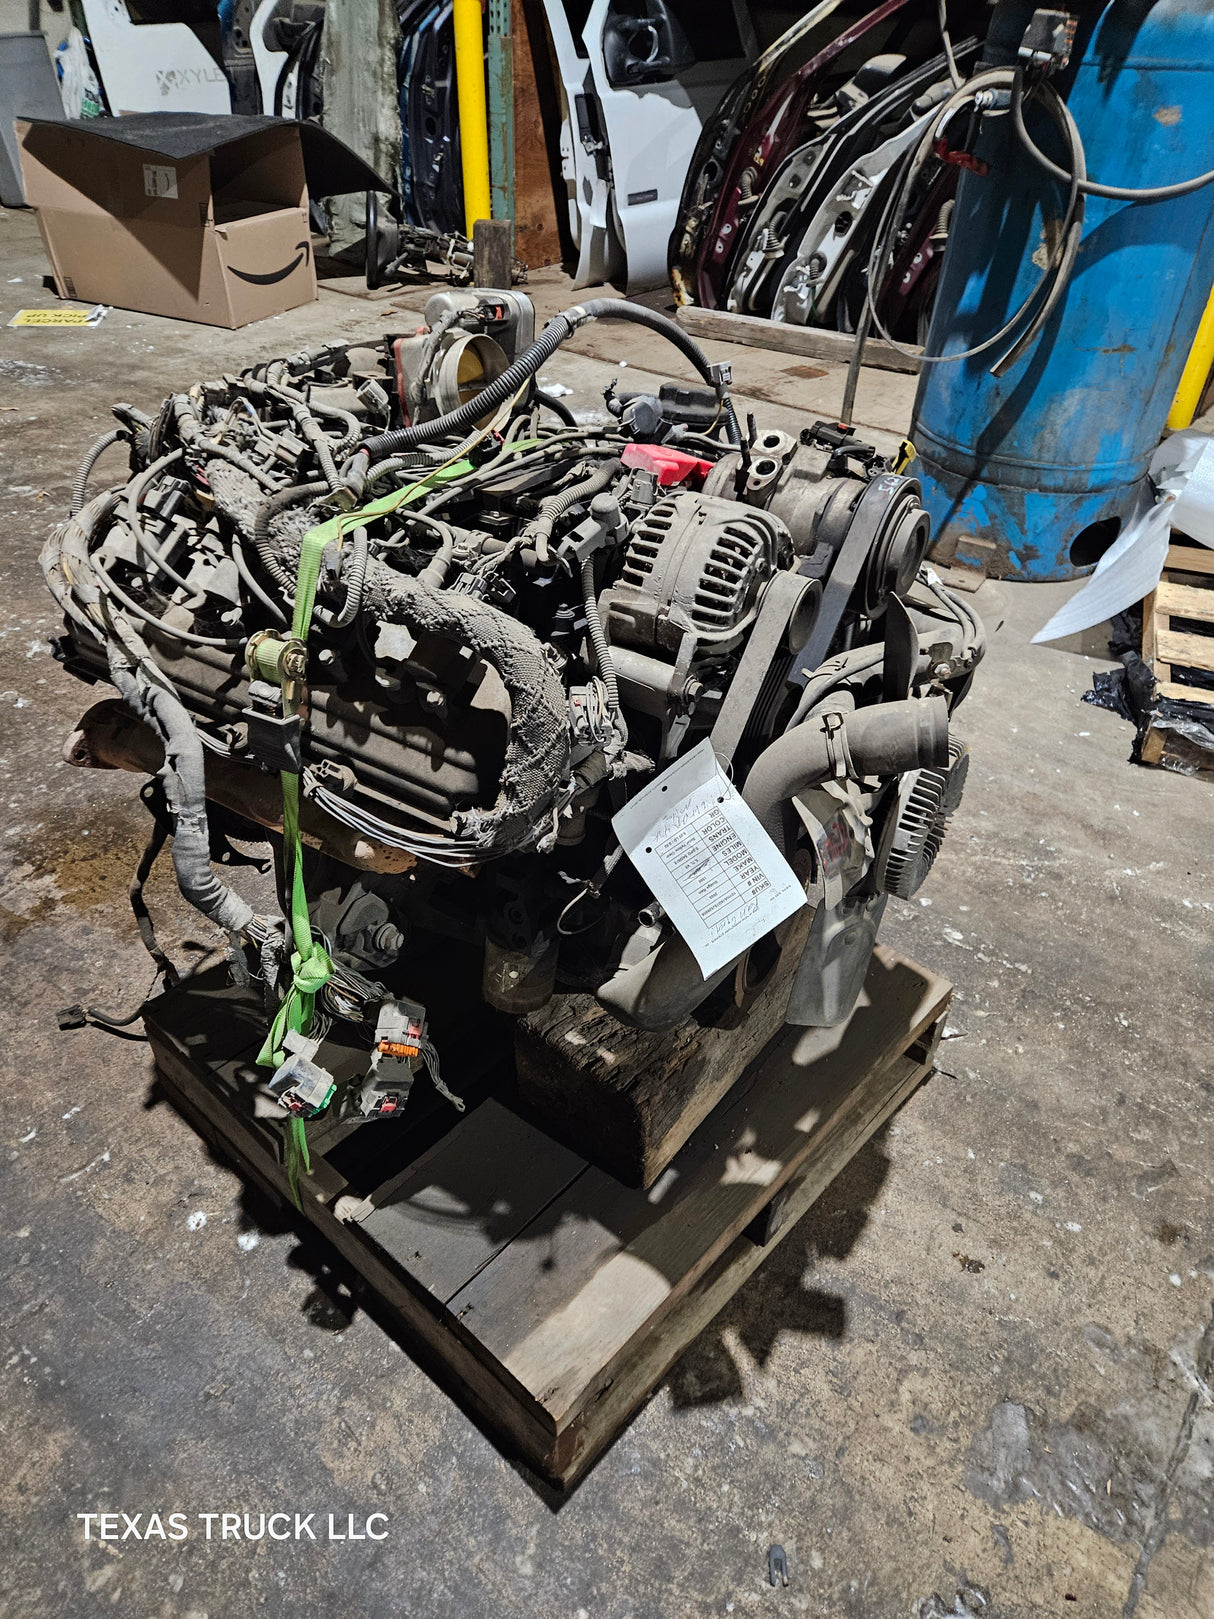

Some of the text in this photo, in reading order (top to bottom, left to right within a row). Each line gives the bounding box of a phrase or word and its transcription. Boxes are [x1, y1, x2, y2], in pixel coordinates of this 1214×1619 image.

[708, 808, 720, 818] GR
[700, 815, 726, 835] COLOR
[706, 823, 731, 843] TRANS
[710, 831, 737, 852] ENGINE
[720, 839, 742, 857] MILES
[722, 847, 748, 867] MODEL
[732, 855, 753, 873] MAKE
[738, 863, 759, 880] YEAR
[751, 871, 764, 883] VIN
[751, 880, 770, 895] SKU#
